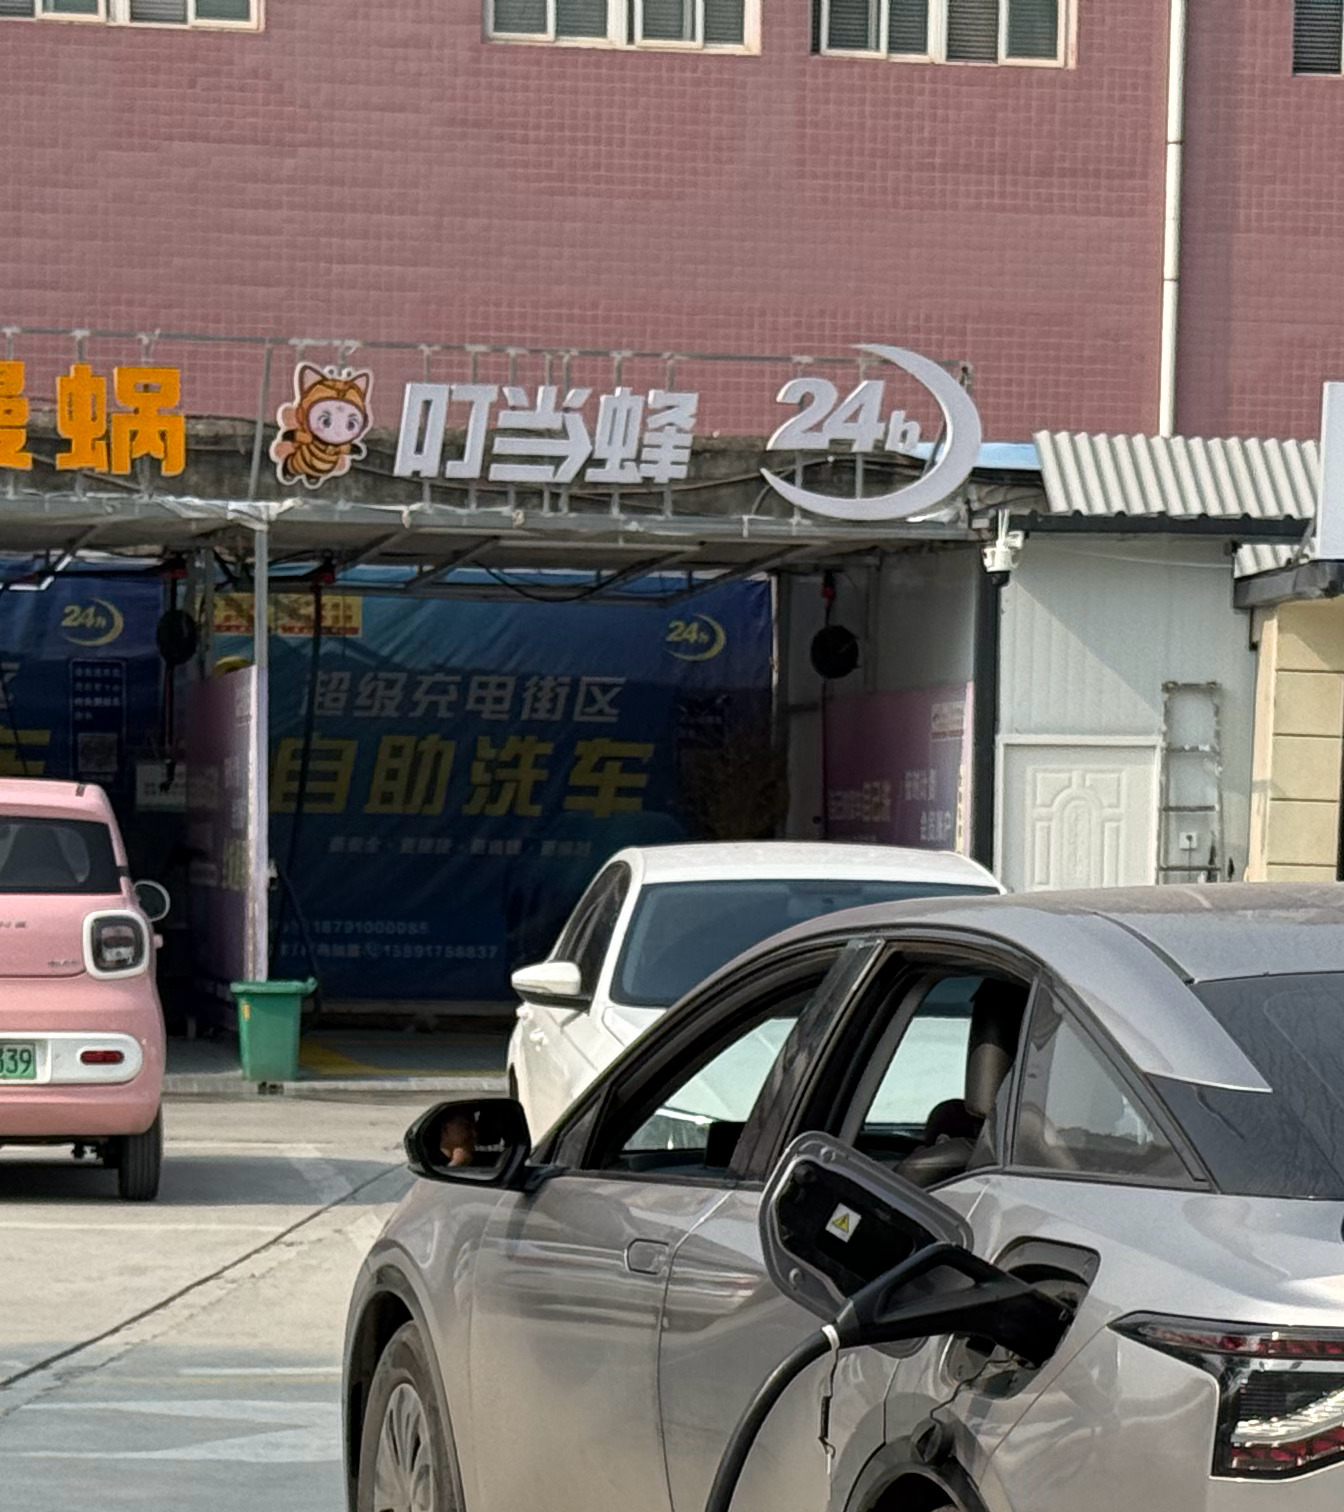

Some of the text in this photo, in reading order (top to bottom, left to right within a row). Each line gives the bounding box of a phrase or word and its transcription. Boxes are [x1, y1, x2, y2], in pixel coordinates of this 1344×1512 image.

[394, 382, 698, 484] 叮当蜂
[766, 377, 922, 455] 24h
[301, 670, 627, 723] 超级充电街区
[269, 732, 654, 818] 自助洗车
